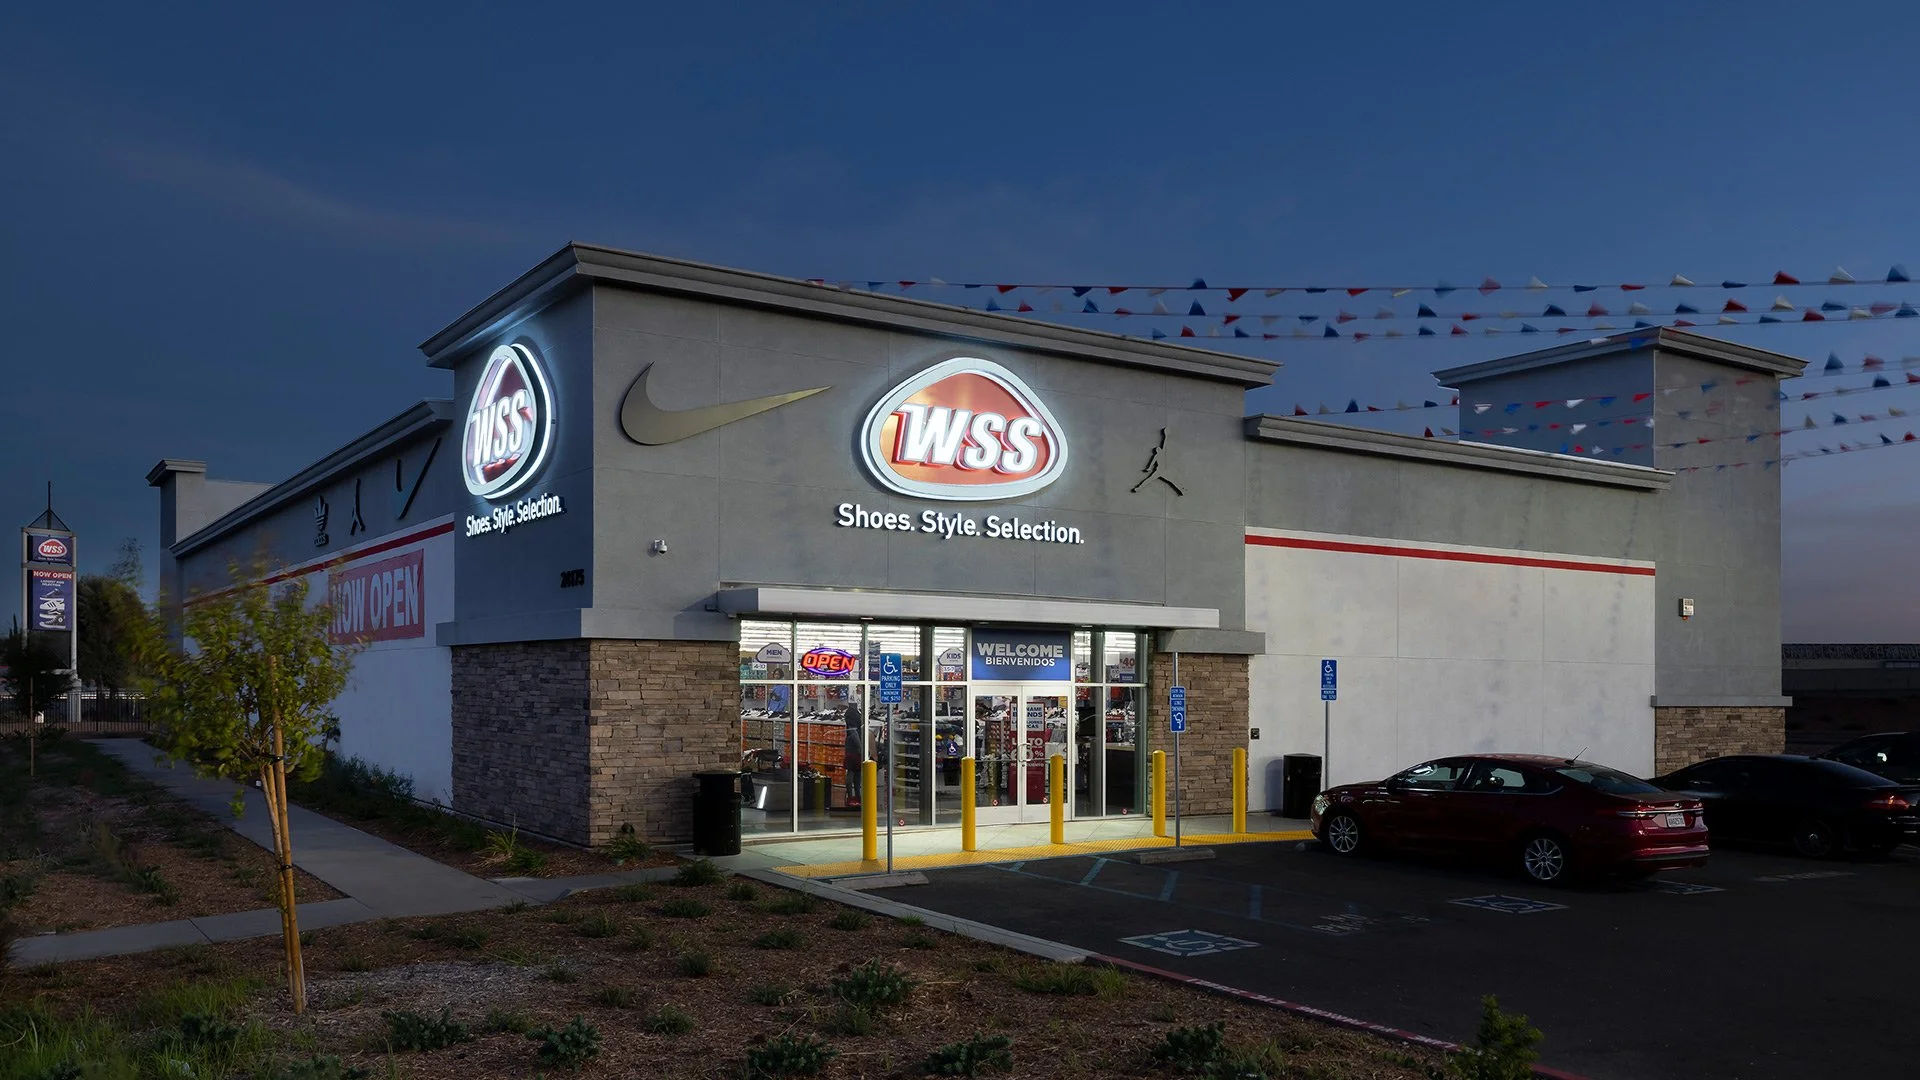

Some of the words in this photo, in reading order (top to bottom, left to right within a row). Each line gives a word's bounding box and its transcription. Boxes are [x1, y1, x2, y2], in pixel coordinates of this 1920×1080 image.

[470, 389, 527, 467] WSS
[895, 403, 1043, 473] WSS
[466, 515, 491, 537] Shoes.
[492, 505, 515, 534] Style.
[517, 493, 561, 522] Selection.
[838, 502, 915, 531] Shoes.
[921, 510, 981, 539] Style.
[986, 515, 1085, 544] Selection.
[43, 545, 63, 554] WSS
[33, 570, 51, 578] NOW
[332, 576, 366, 634] NOW
[369, 564, 419, 631] OPEN
[976, 642, 1063, 658] WELCOME
[802, 653, 855, 672] OPEN
[985, 656, 1055, 667] BIENVENIDOS
[1027, 737, 1044, 747] TO
